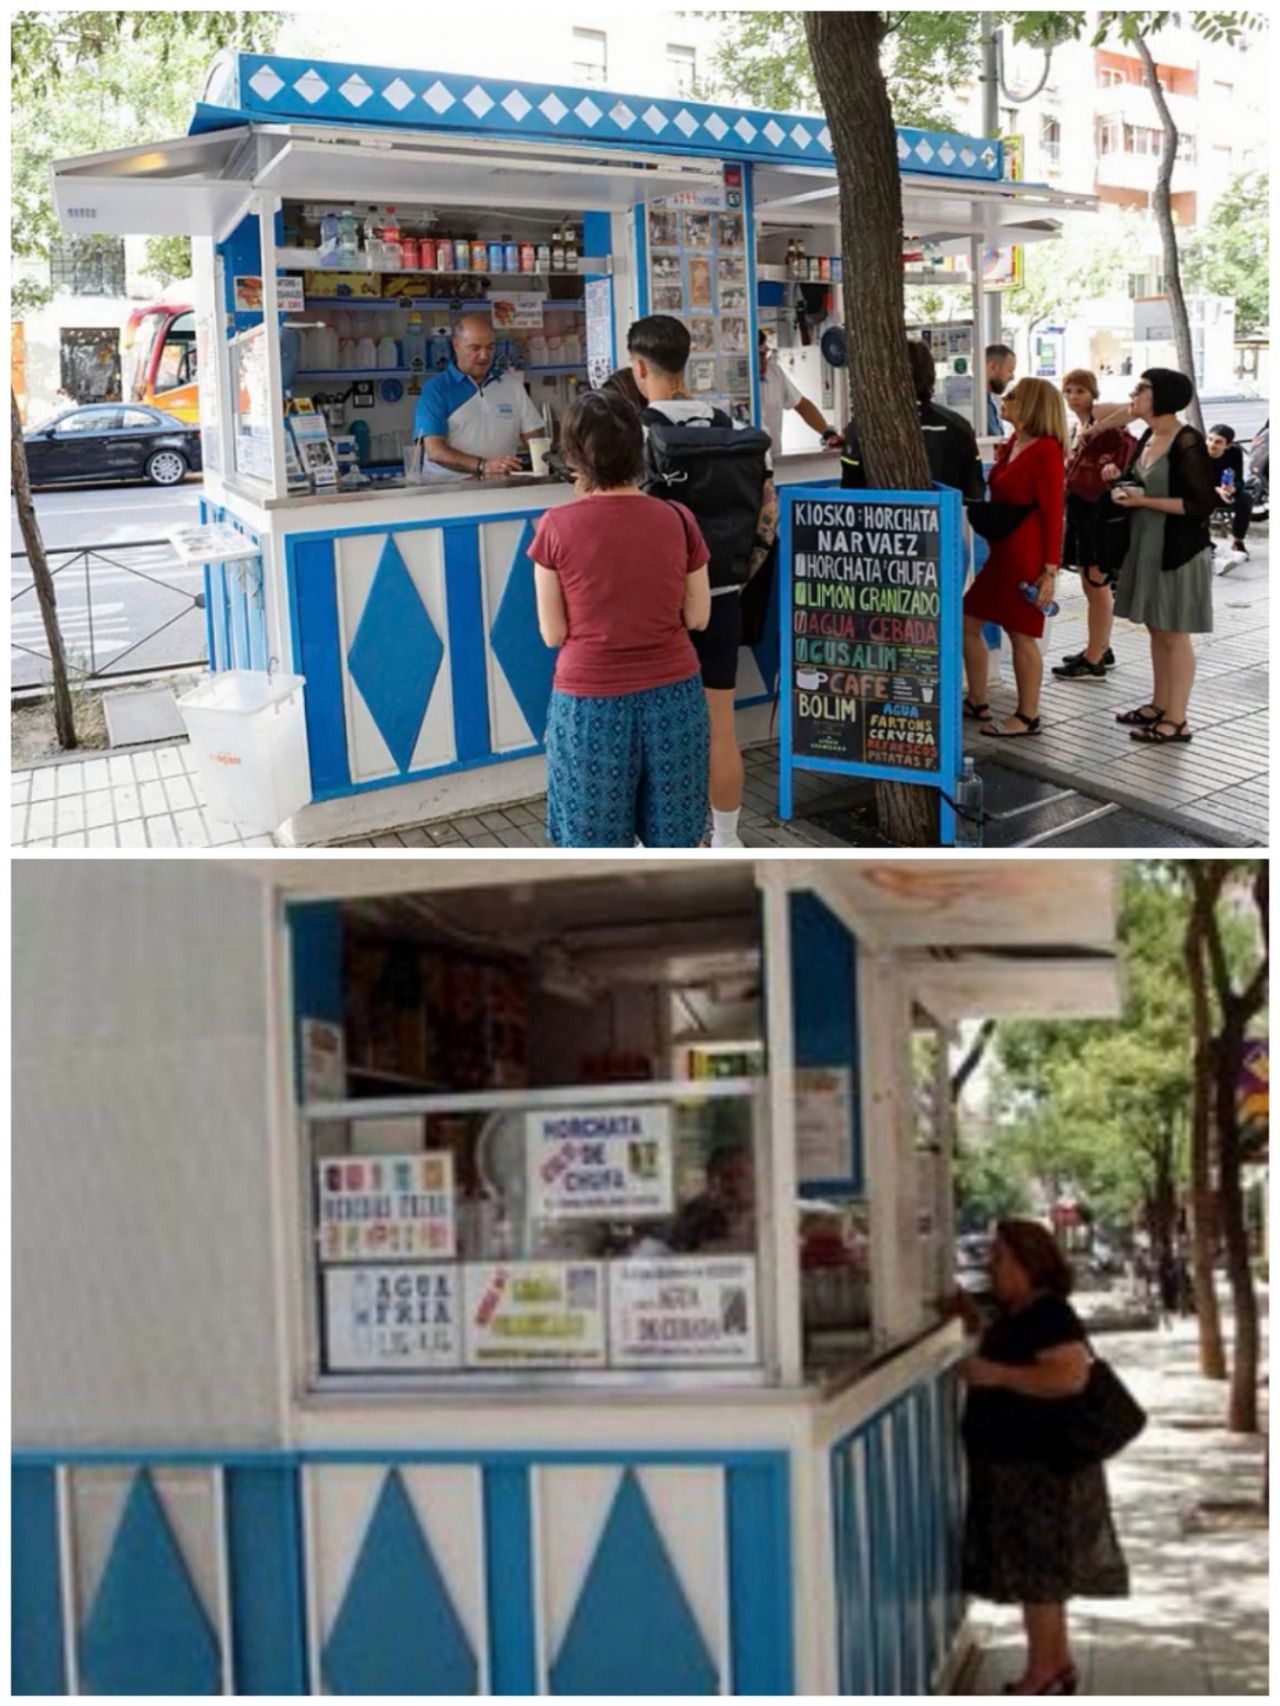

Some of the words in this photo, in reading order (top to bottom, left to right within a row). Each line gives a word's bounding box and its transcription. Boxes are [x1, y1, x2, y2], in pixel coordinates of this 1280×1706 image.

[795, 503, 855, 527] KIOSKO
[864, 506, 939, 532] HORCHATA
[817, 530, 918, 556] NARVAEZ
[807, 554, 882, 583] HORCHATA
[887, 559, 938, 587] CHUFA
[860, 586, 939, 617] GRANIZADO
[808, 612, 855, 638] AGUA
[868, 617, 938, 645] CEBADA
[830, 672, 889, 699] CAFE
[799, 693, 856, 723] BOLIM
[883, 703, 919, 719] AGUA
[870, 713, 932, 732] FARTONS
[869, 728, 935, 745] CERVEZA
[544, 1116, 642, 1139] HORCHATA
